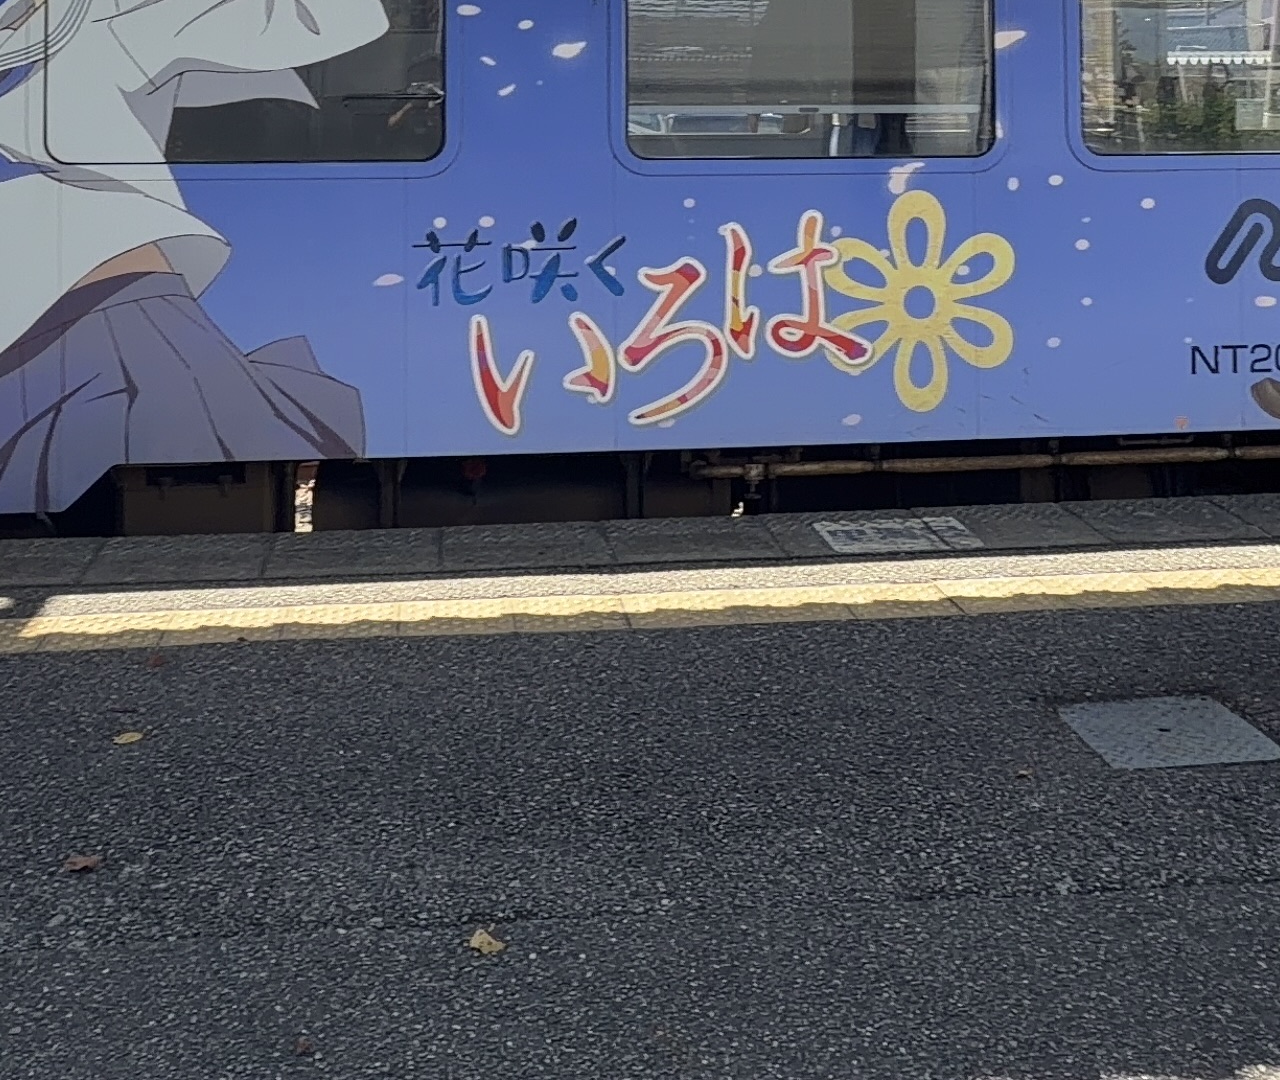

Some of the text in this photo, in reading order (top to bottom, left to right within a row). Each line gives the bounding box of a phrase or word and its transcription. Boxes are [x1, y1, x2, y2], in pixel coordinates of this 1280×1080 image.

[412, 217, 627, 307] 花咲く
[469, 209, 875, 435] いろは
